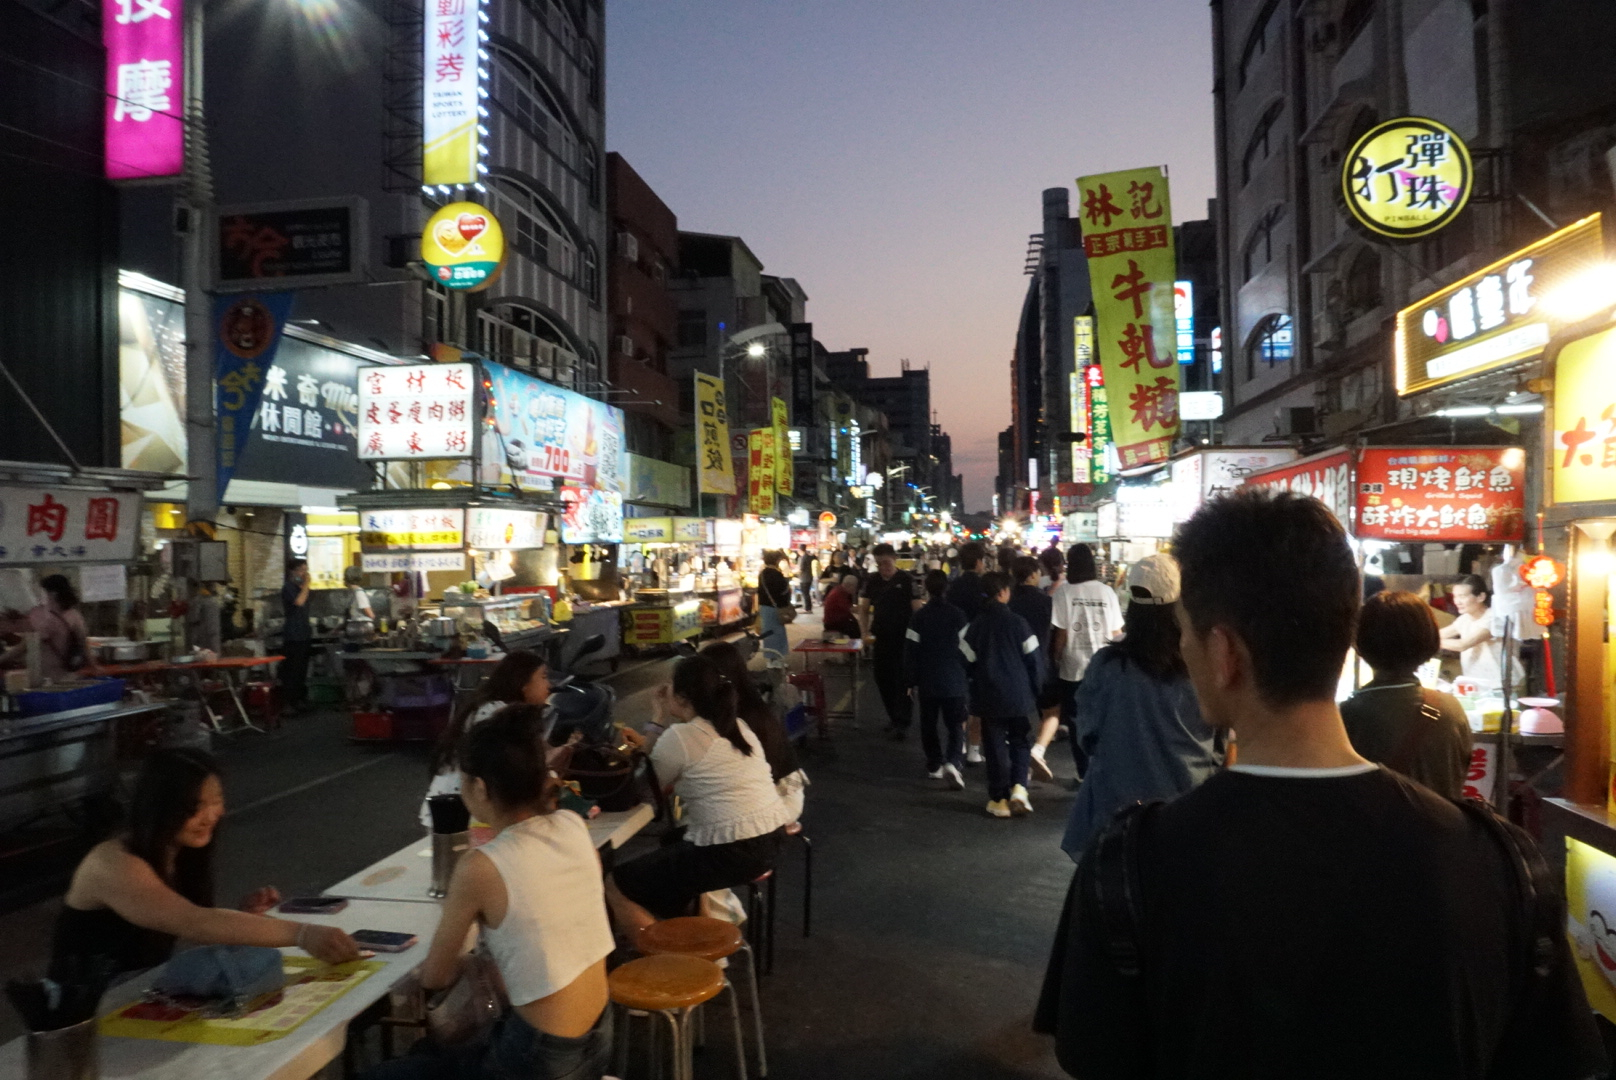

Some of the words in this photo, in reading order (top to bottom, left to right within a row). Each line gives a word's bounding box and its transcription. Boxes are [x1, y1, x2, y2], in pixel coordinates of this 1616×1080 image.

[1352, 132, 1448, 209] 打彈珠
[1084, 180, 1163, 227] 林記
[1110, 259, 1178, 432] 牛軋糖
[1387, 466, 1515, 492] 現烤魷魚
[1361, 503, 1489, 530] 酥炸大魷魚
